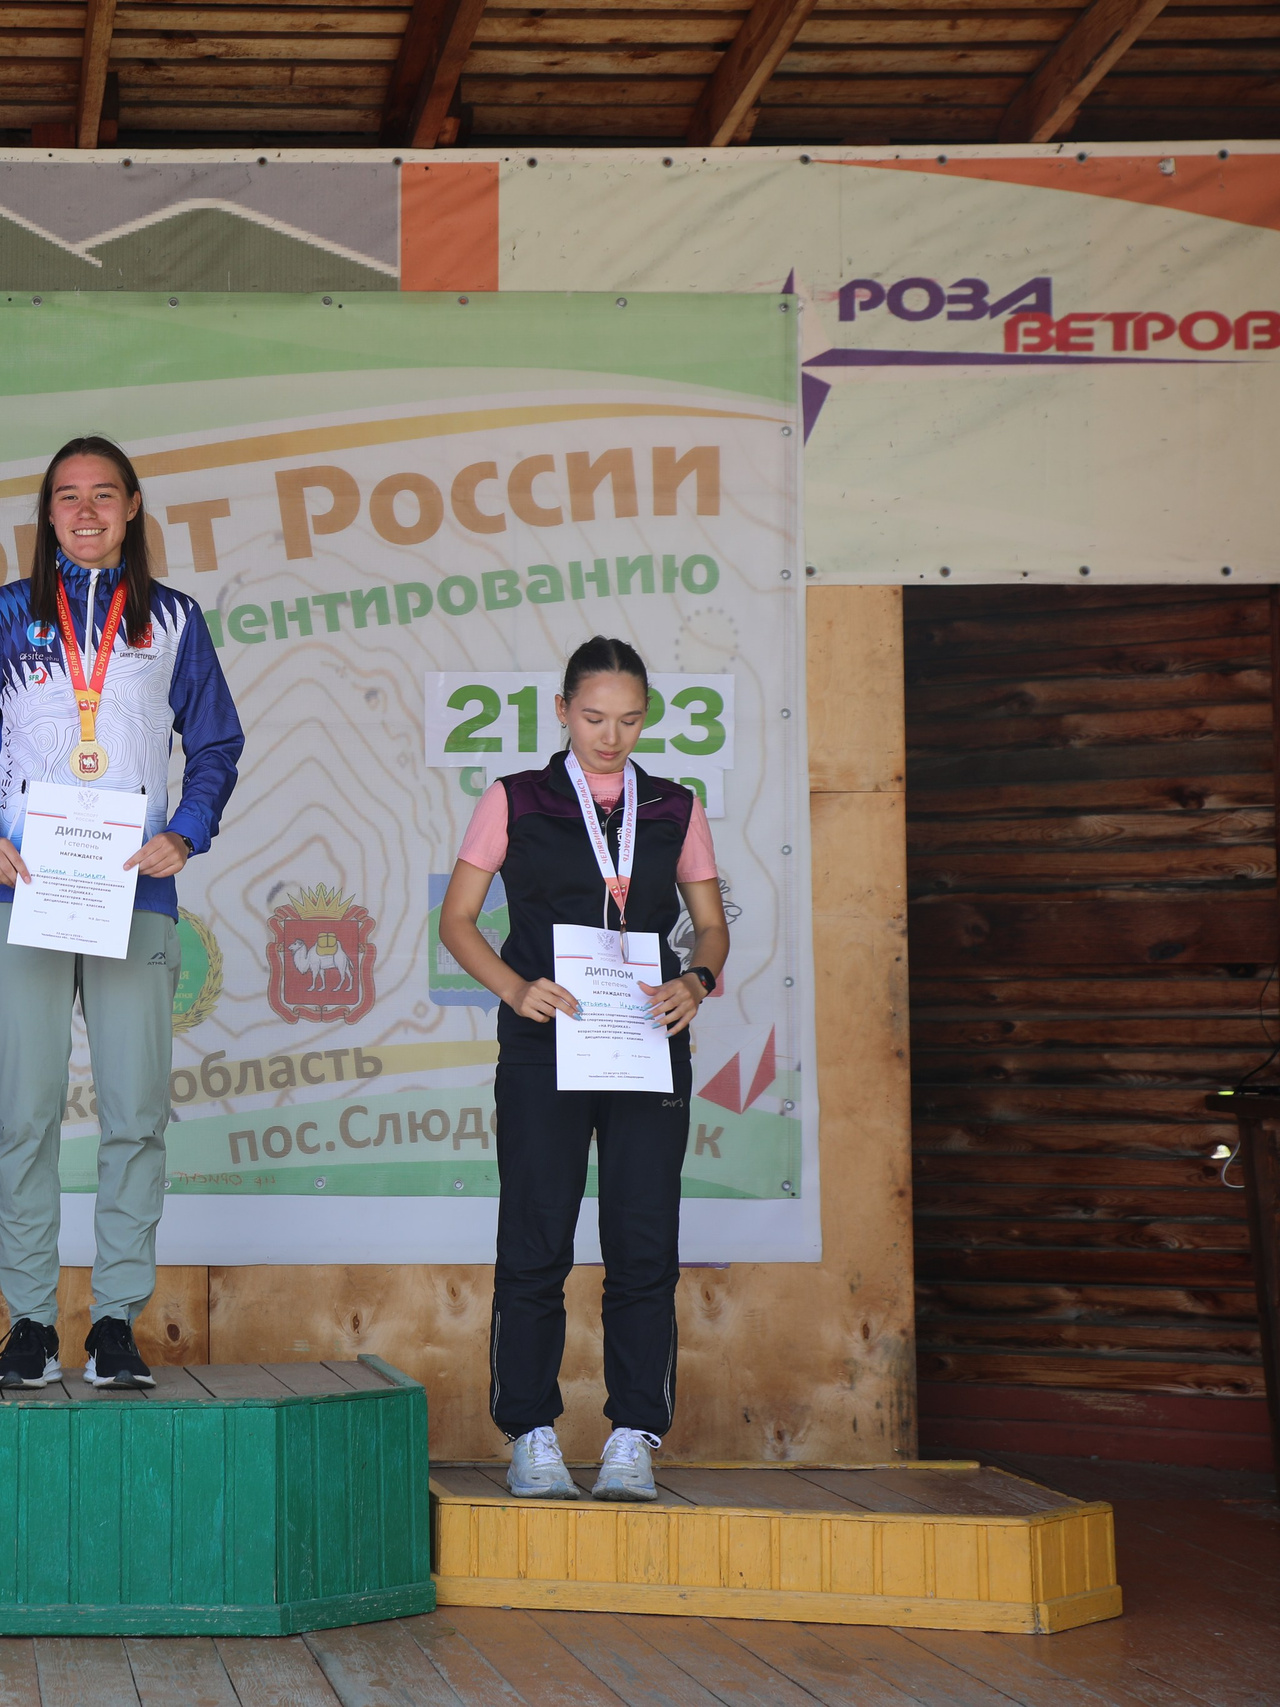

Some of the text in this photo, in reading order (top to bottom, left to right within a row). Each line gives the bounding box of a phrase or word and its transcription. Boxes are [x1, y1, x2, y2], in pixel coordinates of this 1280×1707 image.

[838, 277, 1053, 322] РОЗА
[1003, 310, 1280, 353] ВЕТРОВ
[275, 445, 721, 561] России
[202, 553, 720, 650] ентированию
[95, 588, 125, 677] ЧЕЛЯБИНСКАЯ ОБЛАСТЬ
[443, 684, 538, 753] 21
[577, 779, 591, 809] ОБЛАСТЬ
[55, 825, 112, 841] ДИПЛОМ
[67, 841, 100, 851] степень
[588, 810, 608, 864] ЧЕЛЯБИНСКАЯ
[622, 827, 633, 862] ОБЛАСТЬ
[59, 850, 103, 861] НАГРАЖДАЕТСЯ
[585, 966, 634, 980] ДИПЛОМ
[600, 981, 629, 989] степень
[592, 990, 632, 998] НАГРАЖДАЕТСЯ
[169, 1046, 383, 1104] область
